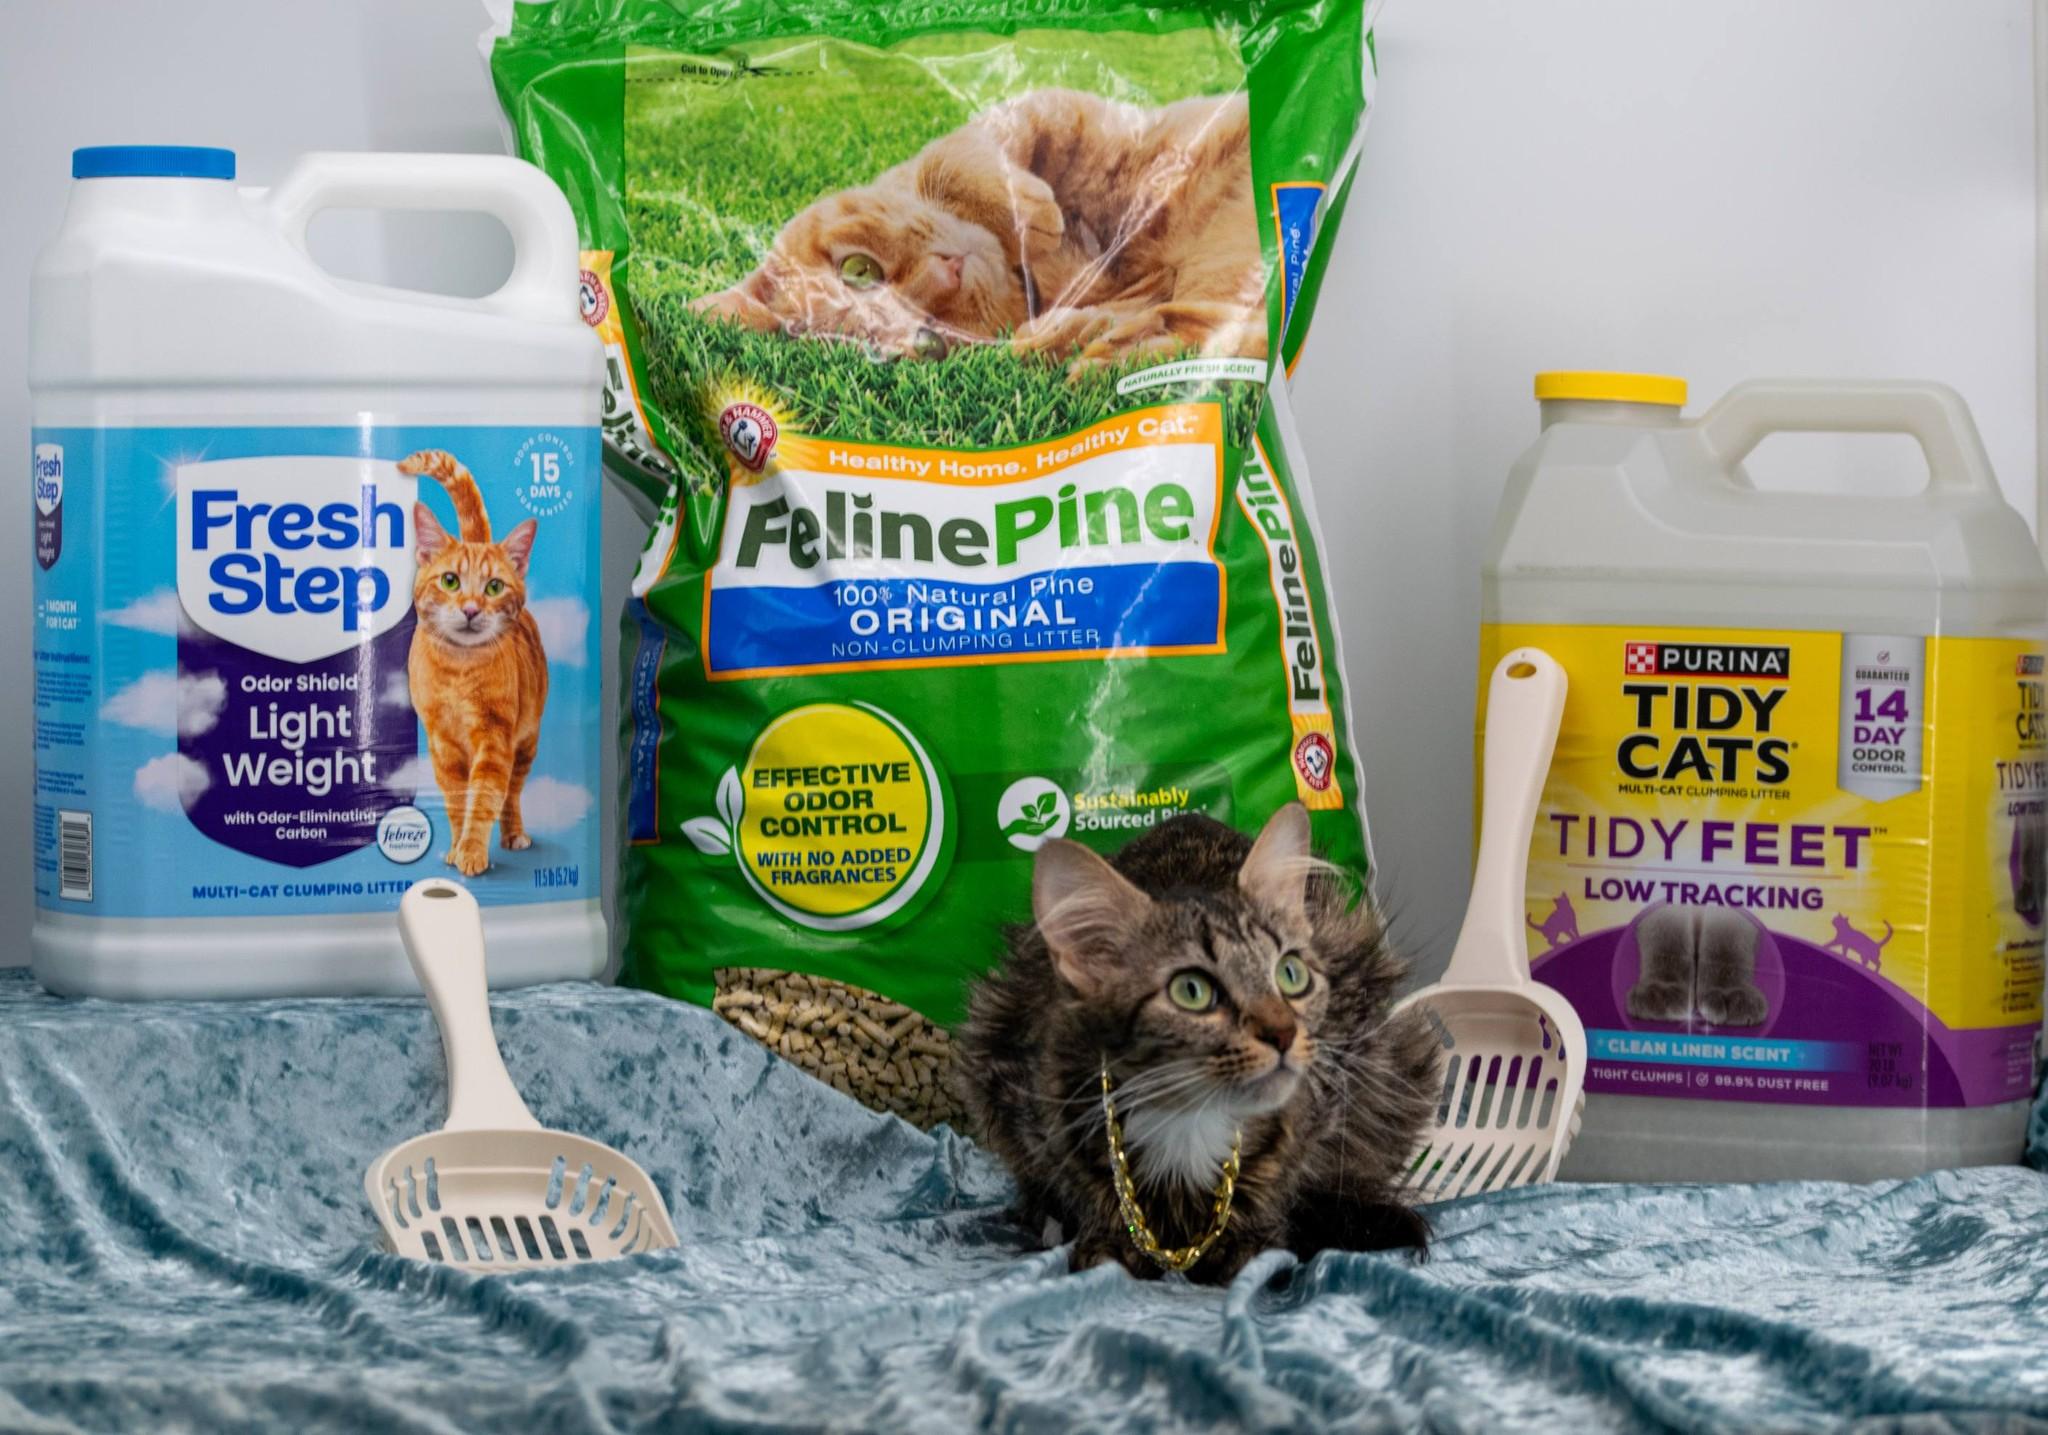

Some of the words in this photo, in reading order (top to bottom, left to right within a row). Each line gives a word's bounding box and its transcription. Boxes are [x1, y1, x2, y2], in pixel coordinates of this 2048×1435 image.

[1124, 367, 1181, 388] NATURALLY
[1185, 364, 1219, 374] FRESH
[828, 450, 931, 476] Healthy
[941, 461, 1027, 479] Home.
[1036, 419, 1129, 470] Healthy
[36, 454, 61, 478] Fresh
[530, 452, 560, 484] 15
[37, 479, 59, 505] Step
[530, 485, 561, 498] DAYS
[192, 485, 405, 550] Fresh
[208, 552, 391, 632] Step
[833, 585, 893, 607] 100%
[907, 583, 1016, 606] Natural
[1031, 573, 1094, 595] Pine
[849, 599, 1076, 635] ORIGINAL
[832, 633, 1013, 657] NON-CLUMPING
[1024, 629, 1099, 646] LITTER
[1663, 648, 1781, 673] PURINA
[241, 674, 292, 692] Odor
[296, 672, 358, 692] Shield
[1855, 669, 1910, 682] GUARANTEED
[1623, 684, 1788, 733] TIDY
[1854, 688, 1909, 723] 14
[250, 702, 352, 750] Light
[1854, 726, 1906, 745] DAY
[1617, 735, 1790, 784] CATS
[1852, 748, 1906, 762] ODOR
[222, 747, 377, 796] Weight
[753, 762, 911, 788] EFFECTIVE
[1852, 763, 1907, 774] CONTROL
[784, 789, 874, 812] ODOR
[1074, 786, 1189, 811] Sustainably
[1618, 784, 1683, 794] MULTI-CAT
[1686, 785, 1748, 799] CLUMPING
[1751, 789, 1790, 800] LITTER
[224, 810, 255, 825] with
[257, 808, 377, 825] Odor-Eliminating
[760, 813, 907, 838] CONTROL
[1075, 808, 1155, 831] Sourced
[275, 827, 327, 839] Carbon
[383, 824, 427, 844] febreze
[757, 851, 801, 867] WITH
[808, 851, 834, 866] NO
[841, 848, 911, 865] ADDED
[771, 867, 897, 885] FRAGRANCES
[192, 883, 278, 899] MULTI-CAT
[284, 882, 363, 897] CLUMPING
[1584, 877, 1656, 901] LOW
[1661, 881, 1823, 910] TRACKING
[1608, 1039, 1667, 1056] CLEAN
[1672, 1043, 1725, 1059] LINEN
[1731, 1046, 1791, 1063] SCENT
[1592, 1068, 1628, 1081] TIGHT
[1631, 1070, 1683, 1084] CLUMPS
[1757, 1076, 1791, 1090] DUST
[1795, 1079, 1829, 1092] FREE
